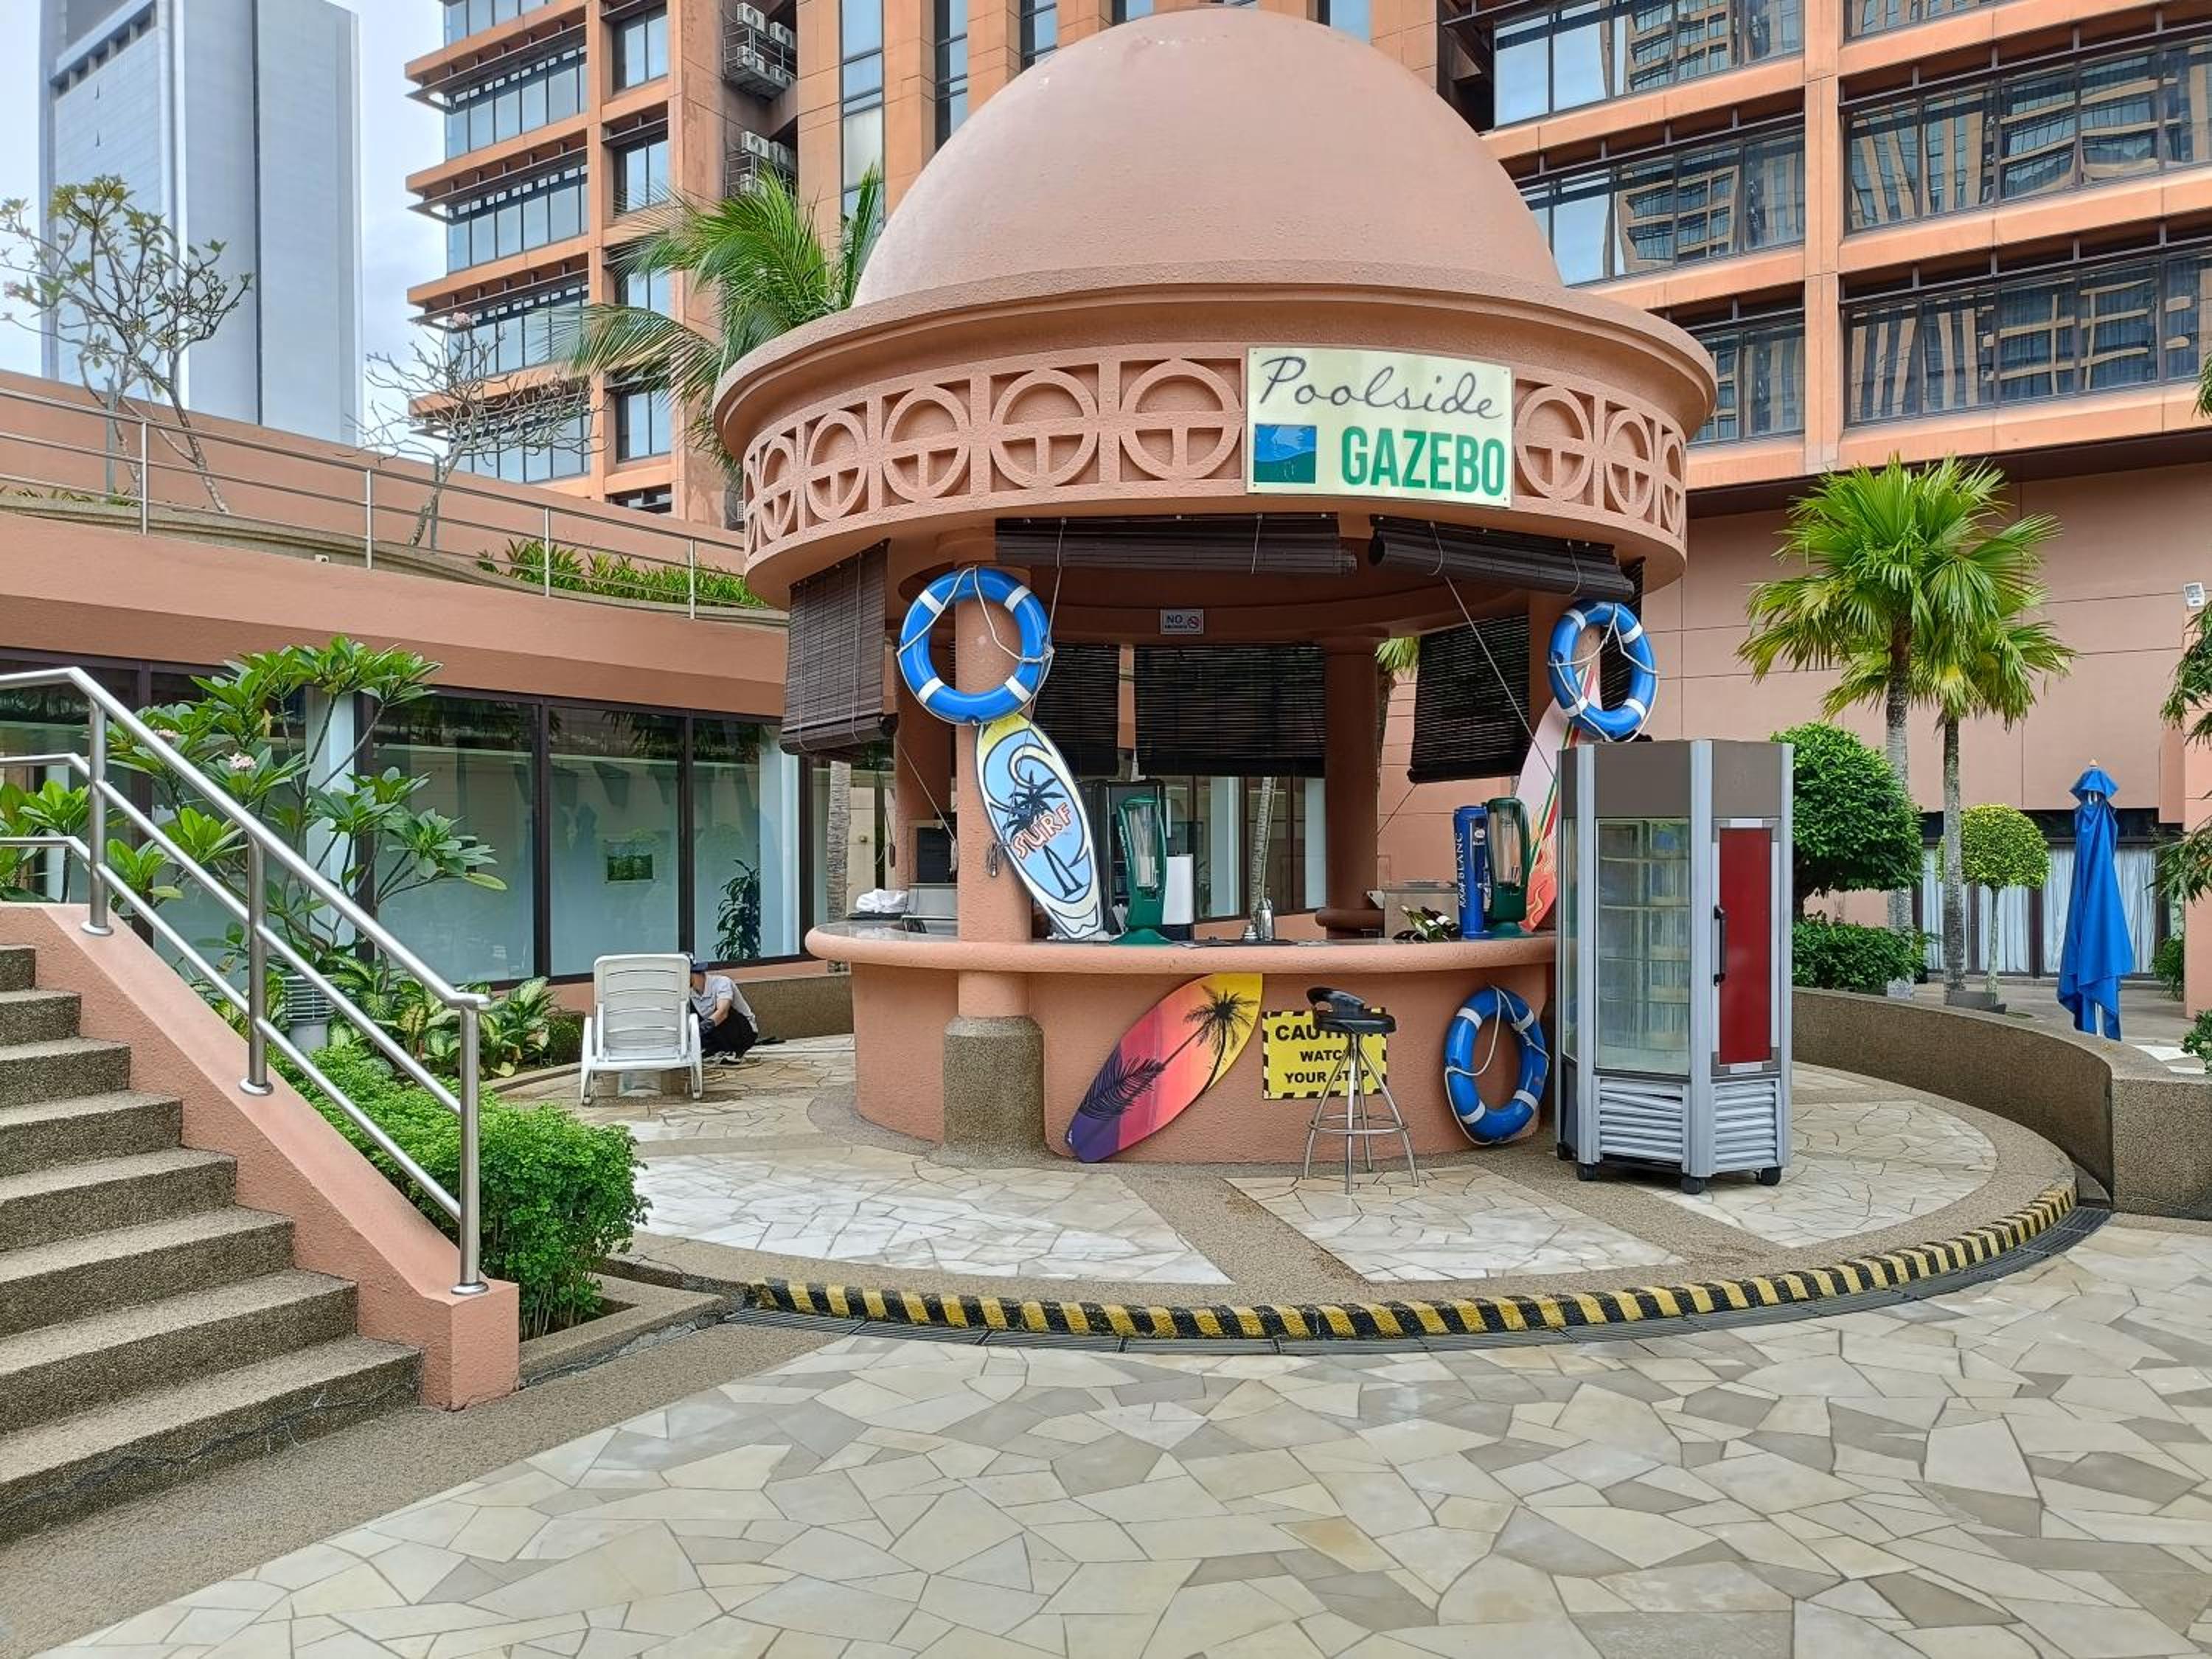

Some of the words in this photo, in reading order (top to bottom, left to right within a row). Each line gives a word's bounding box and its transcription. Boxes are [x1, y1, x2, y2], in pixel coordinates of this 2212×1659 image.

[1259, 355, 1503, 420] Poolside
[1340, 425, 1506, 496] GAZEBO
[1167, 614, 1183, 624] NO
[1012, 801, 1071, 860] SURF
[1455, 832, 1465, 879] BLANC
[1284, 1071, 1326, 1083] YOUR
[1335, 1070, 1369, 1082] STP
[1300, 1049, 1348, 1062] WATC
